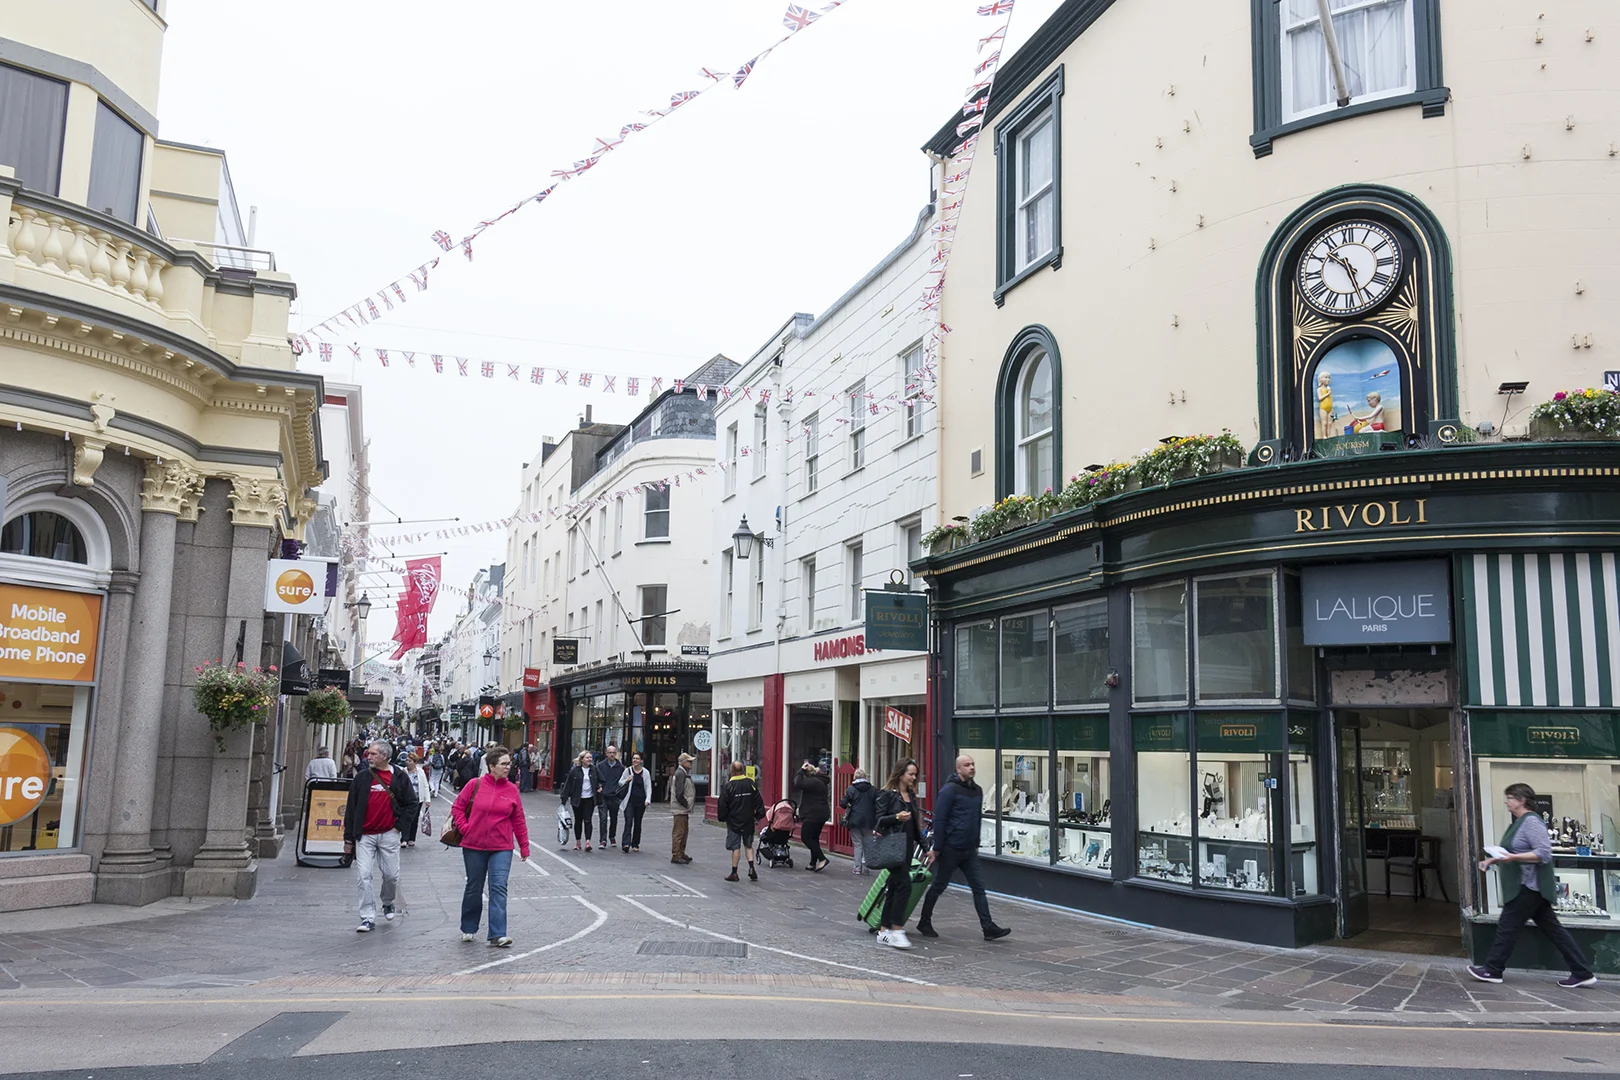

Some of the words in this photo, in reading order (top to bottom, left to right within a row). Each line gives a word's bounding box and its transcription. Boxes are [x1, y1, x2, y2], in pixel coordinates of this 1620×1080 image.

[1607, 373, 1620, 387] N
[1294, 499, 1428, 532] RIVOLI
[11, 603, 67, 623] Mobile
[1315, 594, 1435, 620] LALIQUE
[876, 611, 918, 622] RIVOLI
[879, 630, 915, 638] Jewellers
[1362, 624, 1388, 632] PARIS
[0, 646, 31, 660] me
[35, 646, 87, 664] Phone
[814, 634, 865, 662] HAMONS
[623, 677, 641, 685] JACK
[645, 676, 677, 685] WILLS
[887, 710, 911, 738] SALE
[1223, 728, 1253, 737] RIVOLI
